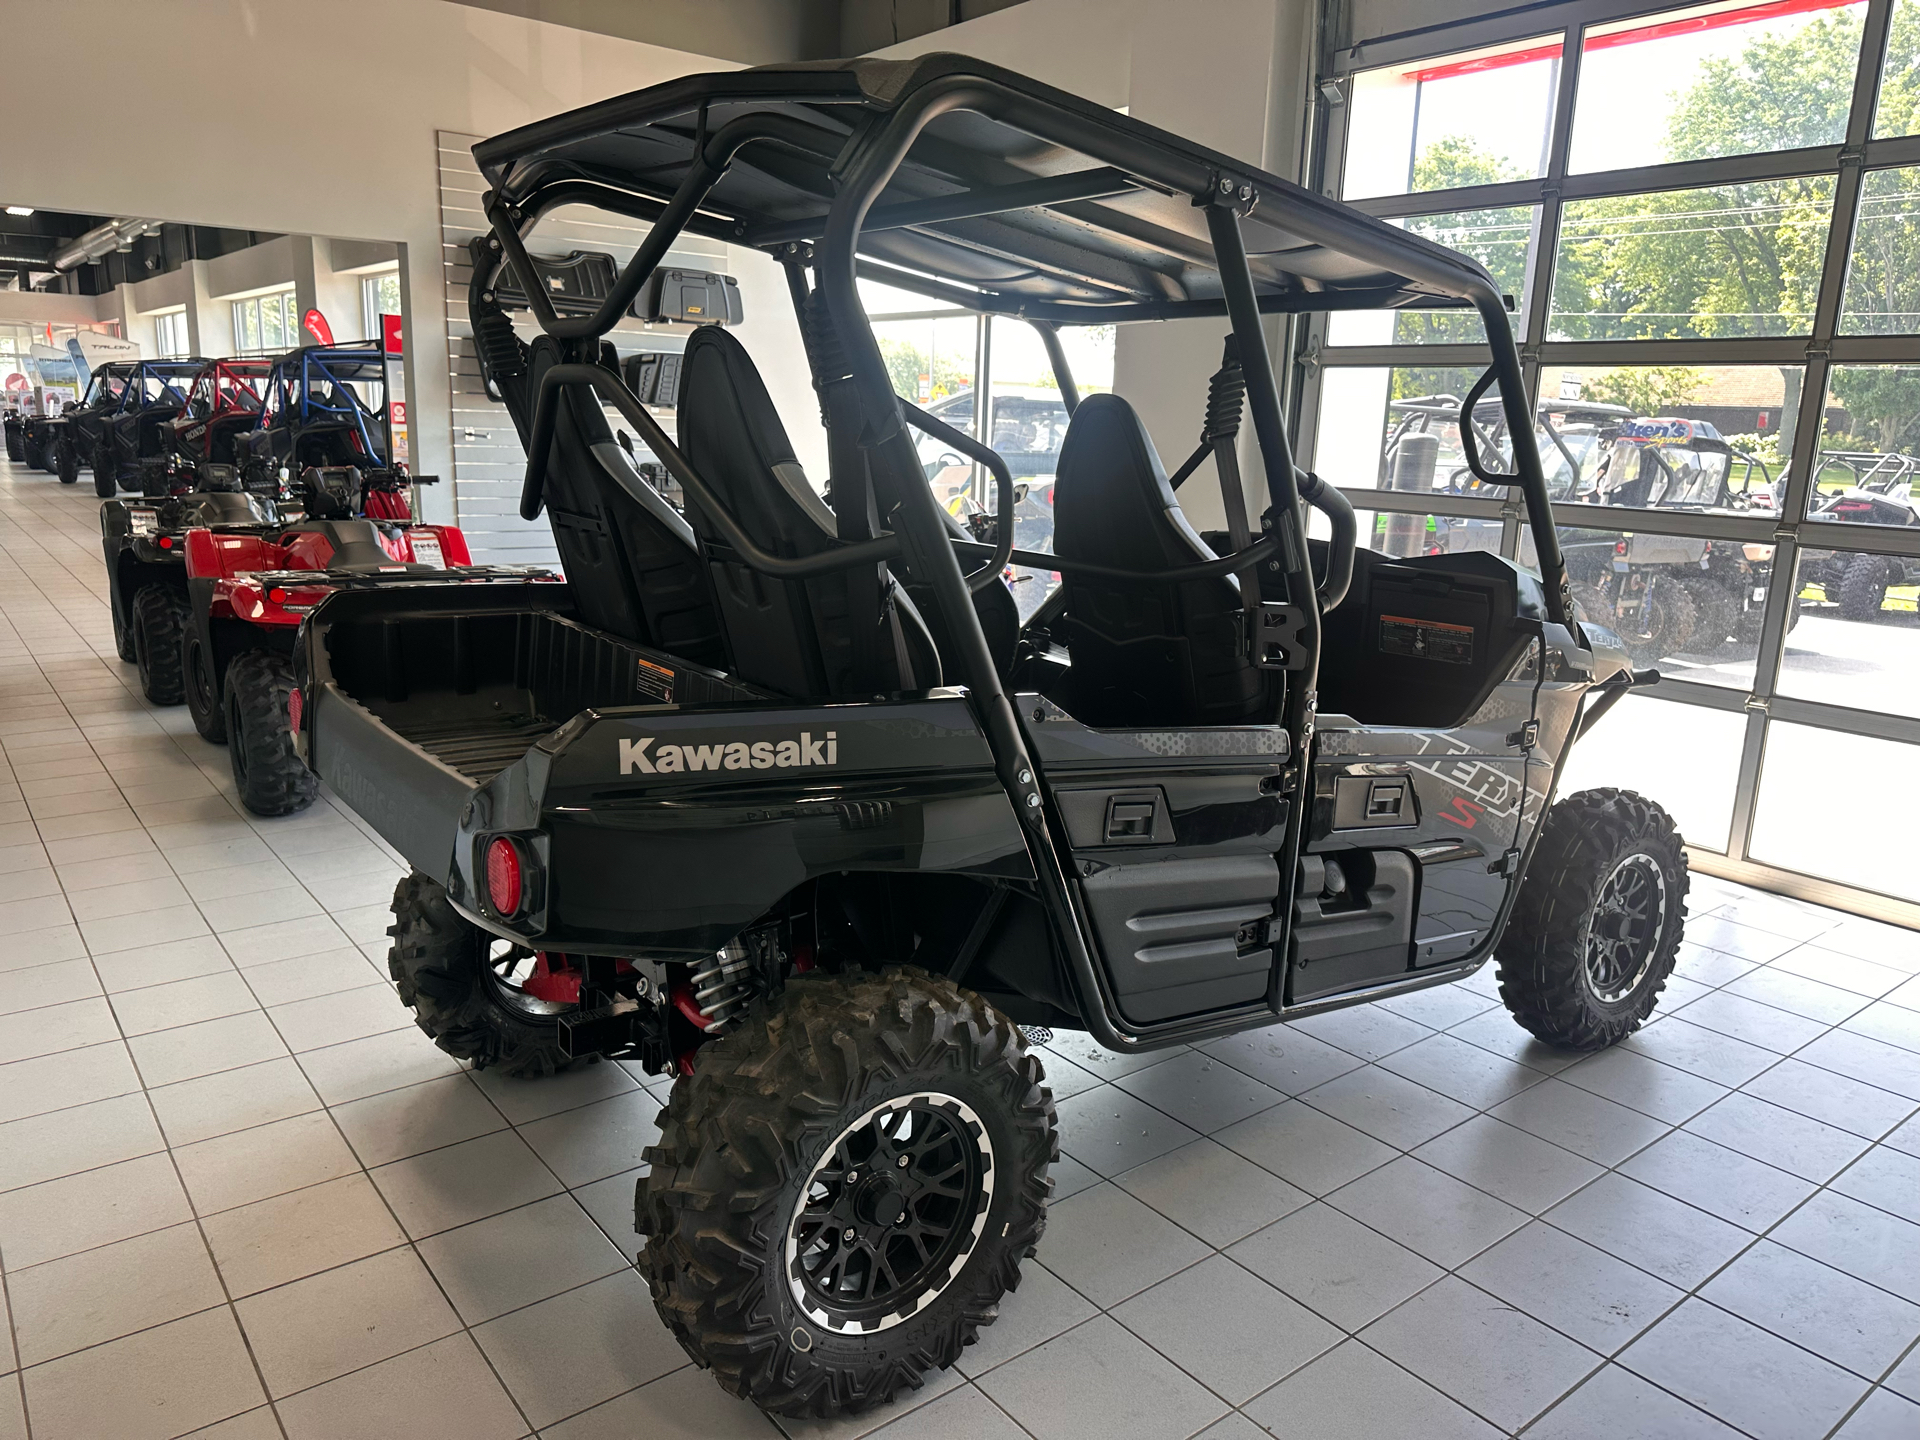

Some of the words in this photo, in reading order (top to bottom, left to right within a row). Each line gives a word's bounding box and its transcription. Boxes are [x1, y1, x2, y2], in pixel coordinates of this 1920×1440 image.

[185, 424, 207, 442] HONDA
[1644, 433, 1688, 449] Sports
[619, 731, 838, 775] Kawasaki
[1437, 796, 1485, 830] S
